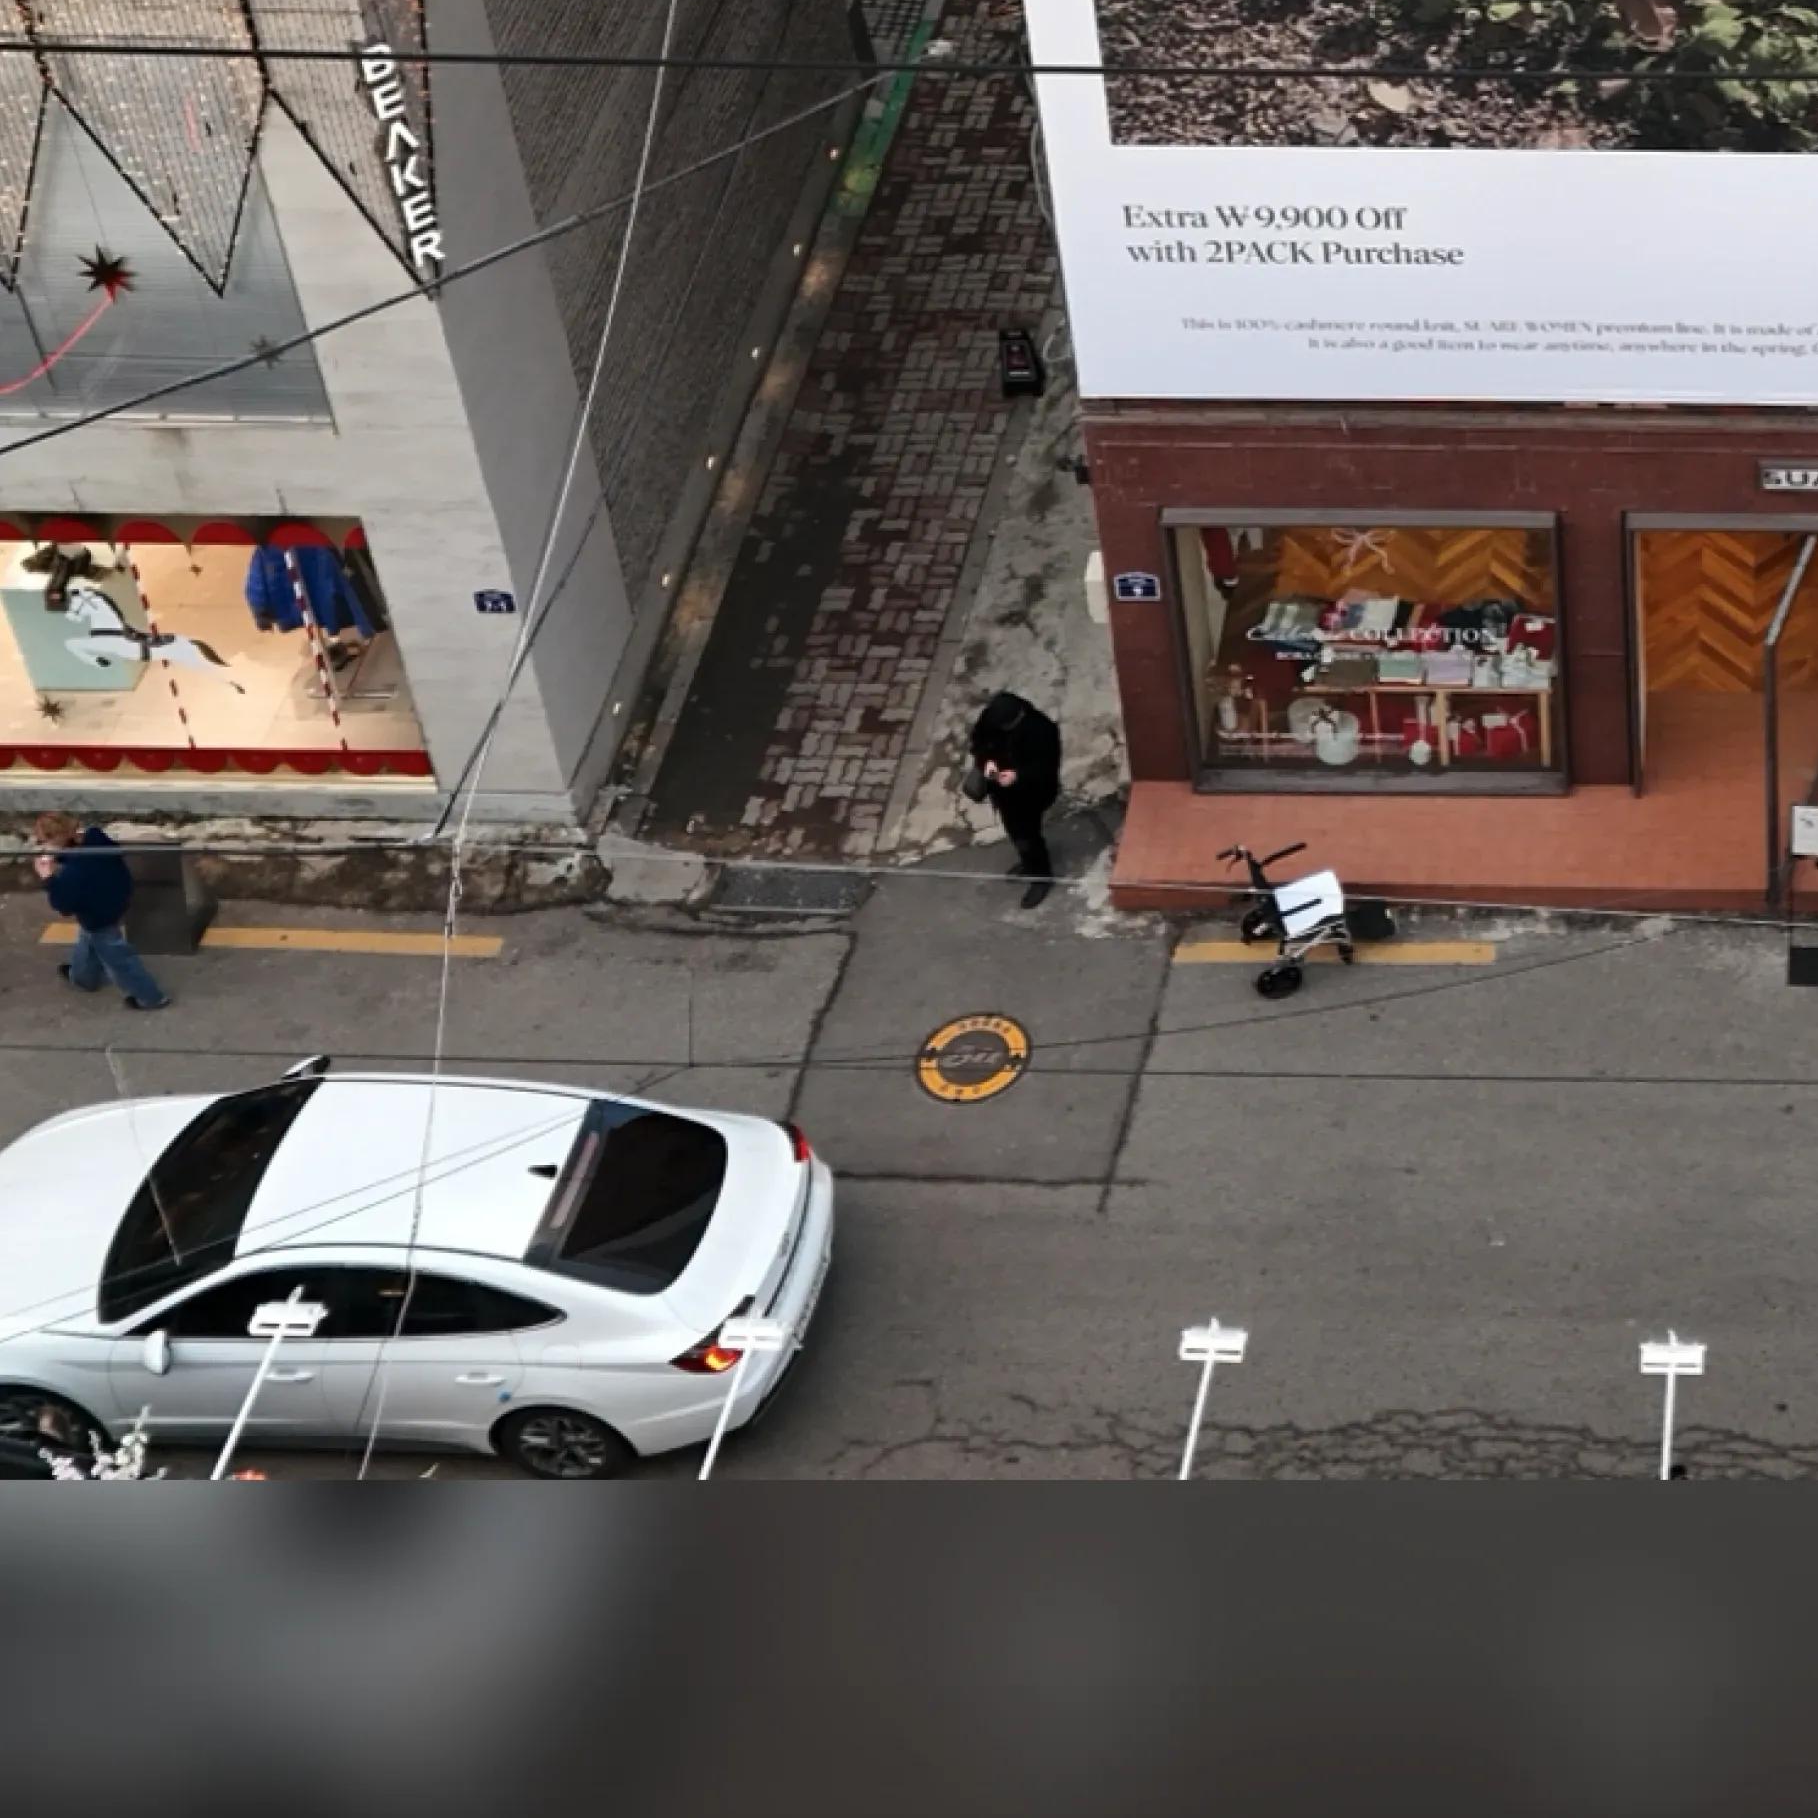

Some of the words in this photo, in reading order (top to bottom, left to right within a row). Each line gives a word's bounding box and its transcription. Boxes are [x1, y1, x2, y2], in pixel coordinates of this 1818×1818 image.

[361, 43, 446, 268] BEAKER
[1121, 204, 1208, 230] Extra
[1355, 205, 1409, 230] Off
[1126, 238, 1198, 265] with
[1204, 239, 1315, 265] 2PACK
[1321, 240, 1465, 266] Purchase
